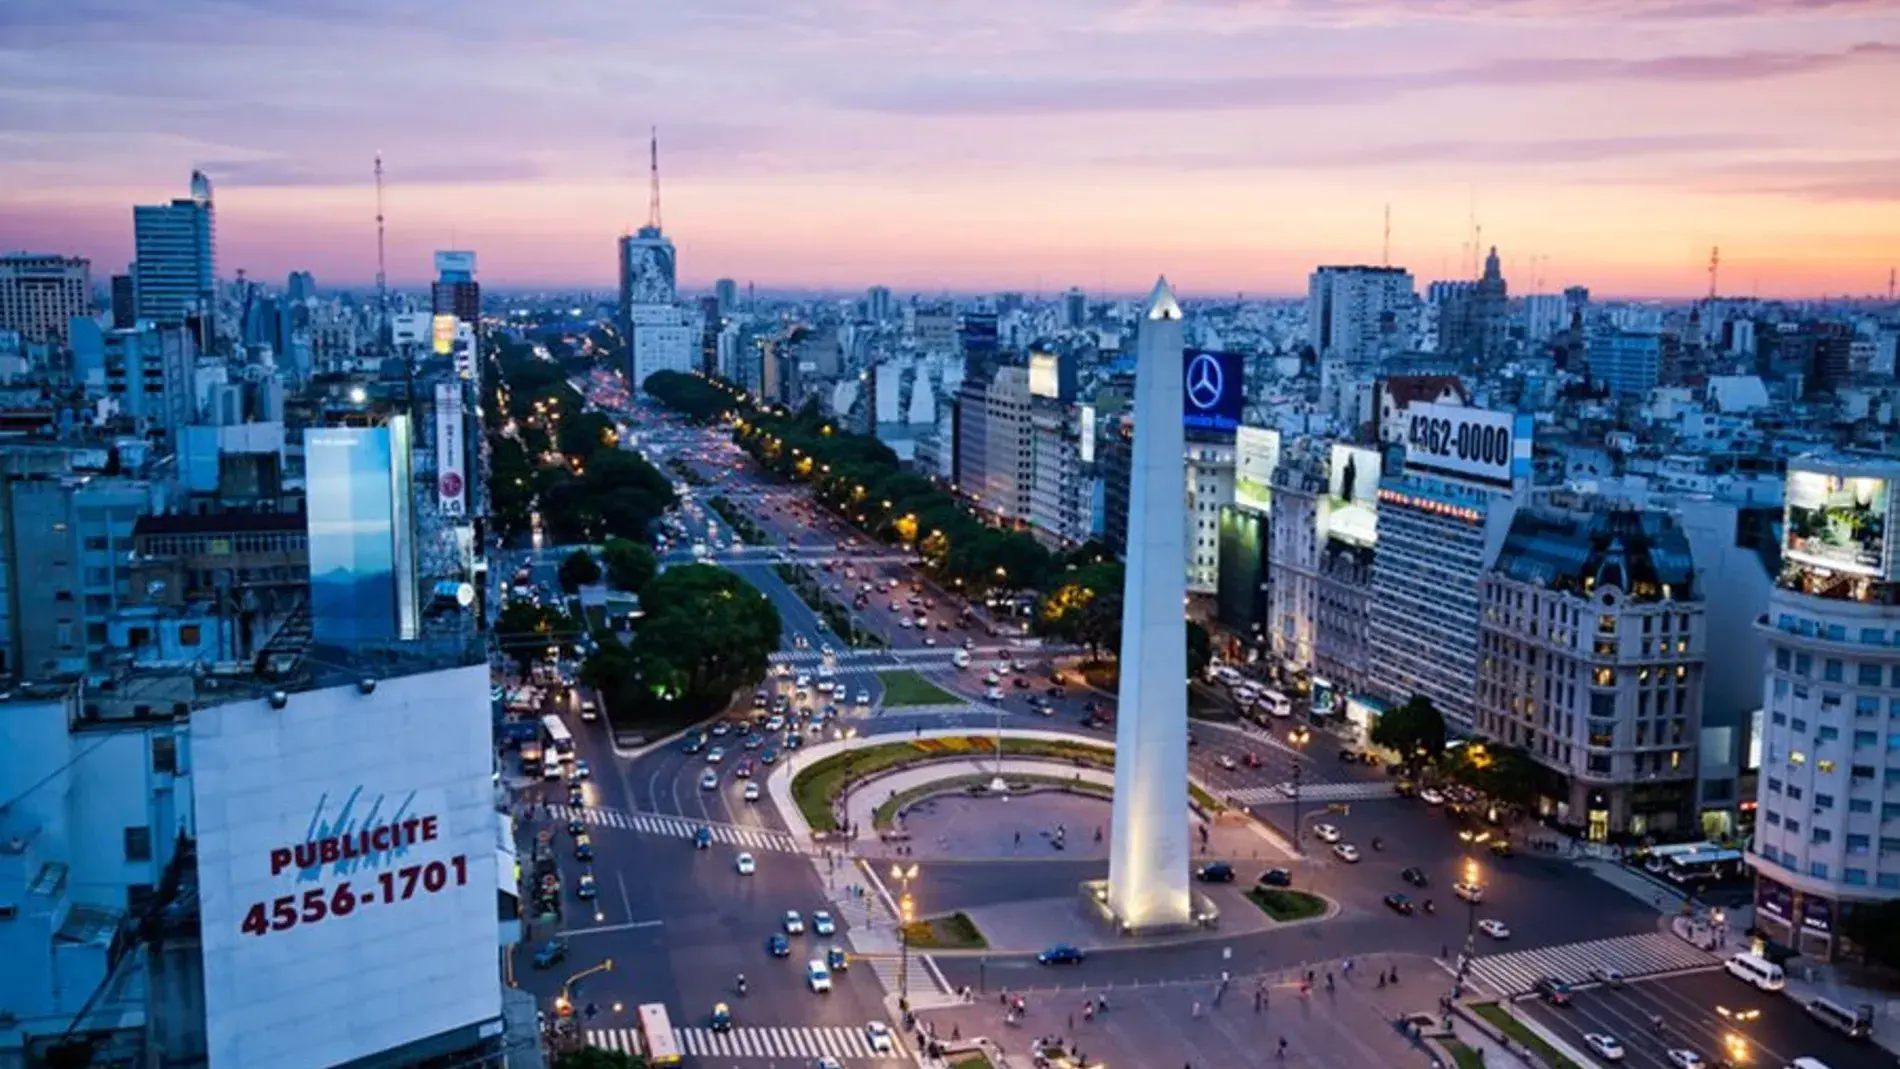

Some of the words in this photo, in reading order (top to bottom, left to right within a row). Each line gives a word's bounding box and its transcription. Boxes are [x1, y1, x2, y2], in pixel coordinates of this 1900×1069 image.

[1409, 414, 1509, 467] 4362-0000
[270, 815, 437, 876] PUBLICITE
[241, 854, 467, 936] 4556-1701
